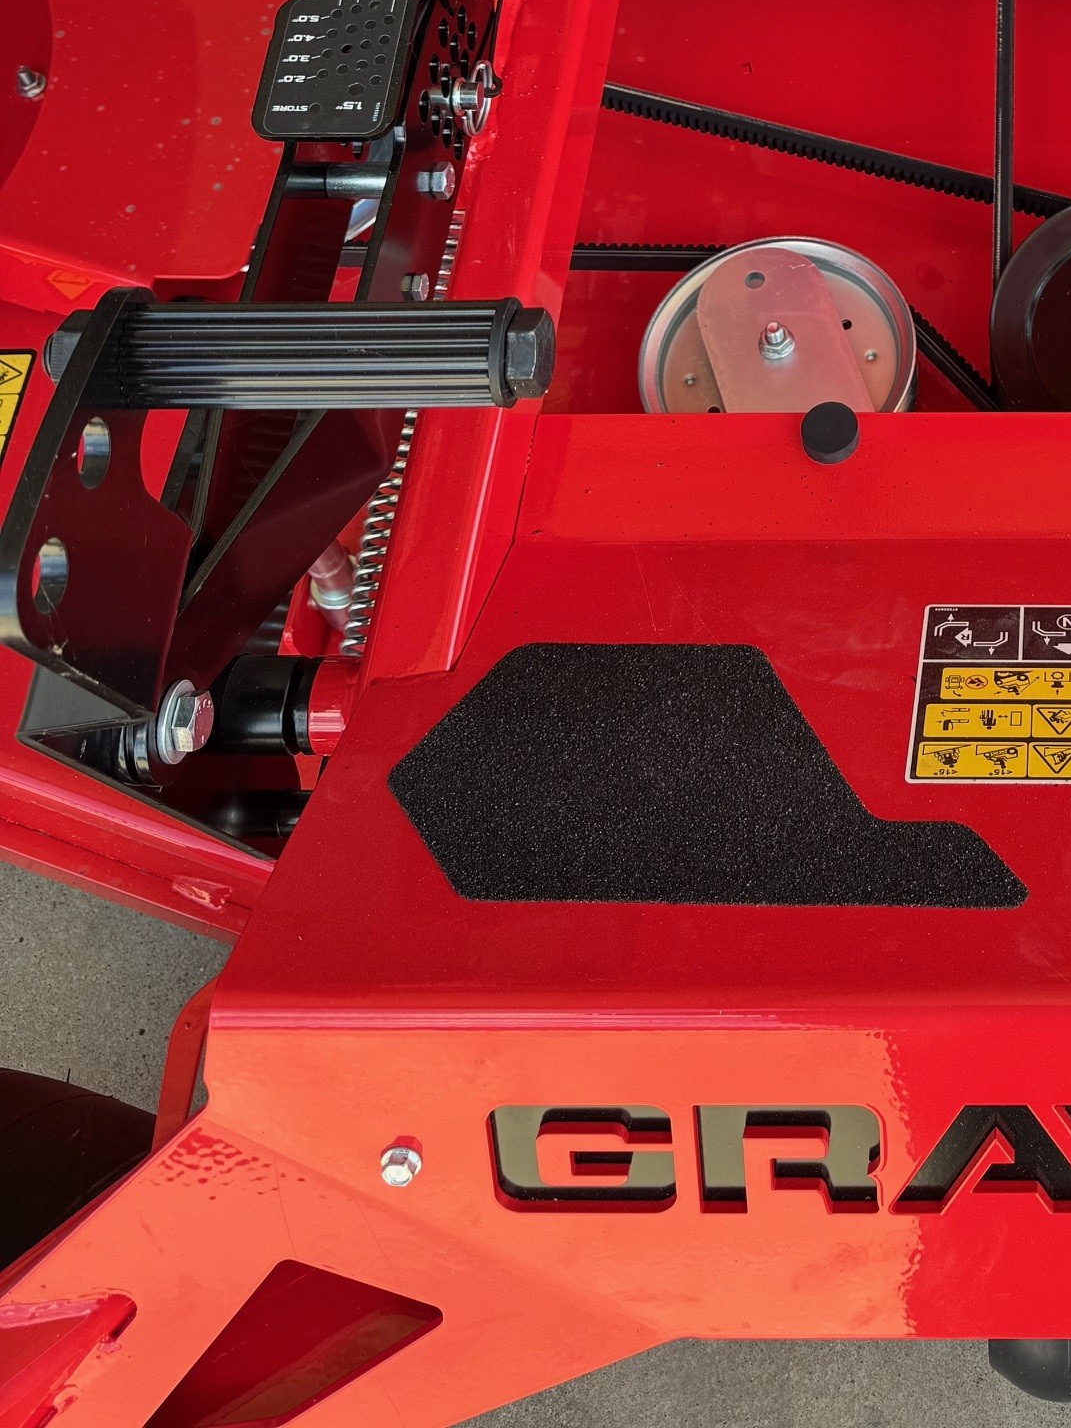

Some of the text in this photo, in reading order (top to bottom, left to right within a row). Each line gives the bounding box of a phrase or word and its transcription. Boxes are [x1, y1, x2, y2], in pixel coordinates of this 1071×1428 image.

[292, 14, 320, 23] 5.0"
[287, 34, 315, 42] 4.0"
[282, 54, 311, 62] 3.0"
[277, 75, 306, 83] 2.0"
[335, 101, 363, 110] 1.5"
